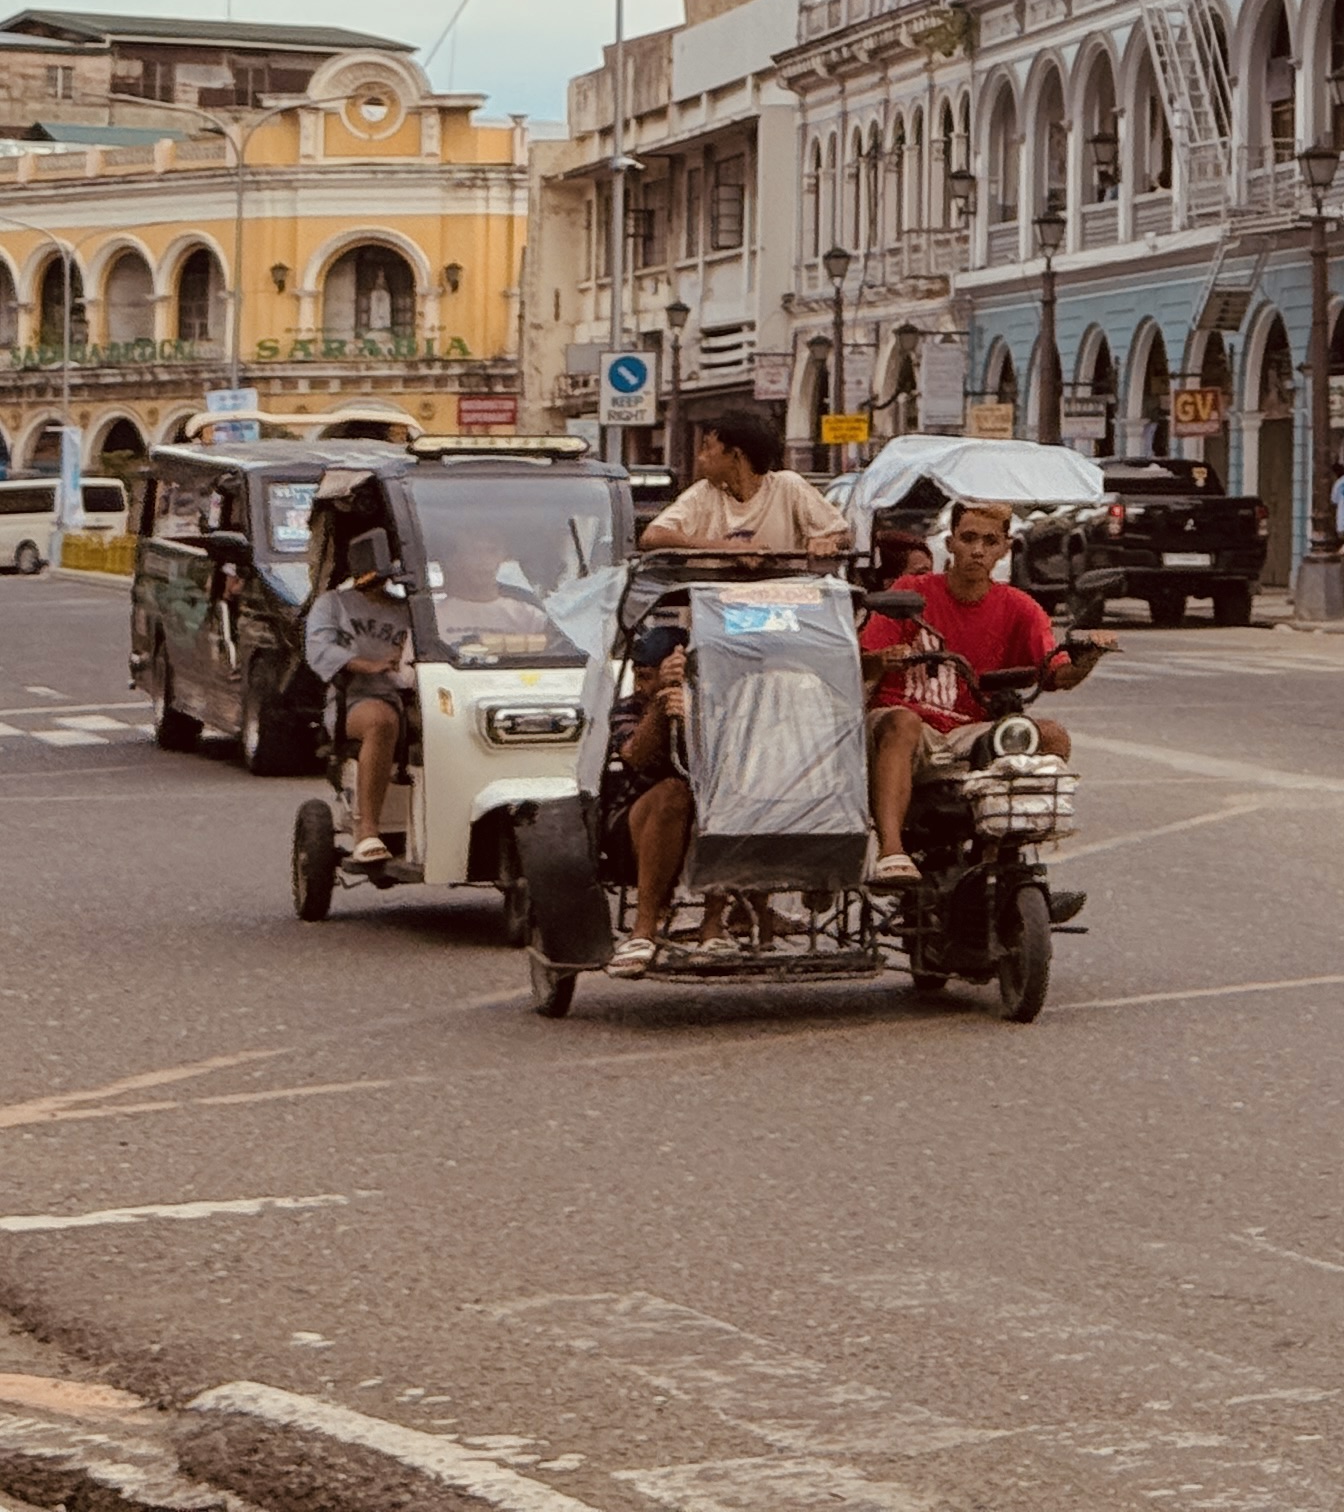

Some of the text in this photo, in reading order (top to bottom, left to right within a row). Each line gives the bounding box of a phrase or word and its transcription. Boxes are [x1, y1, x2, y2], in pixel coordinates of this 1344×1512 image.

[256, 337, 472, 361] SARABIA
[611, 396, 644, 408] KEEP
[607, 409, 647, 422] RIGHT
